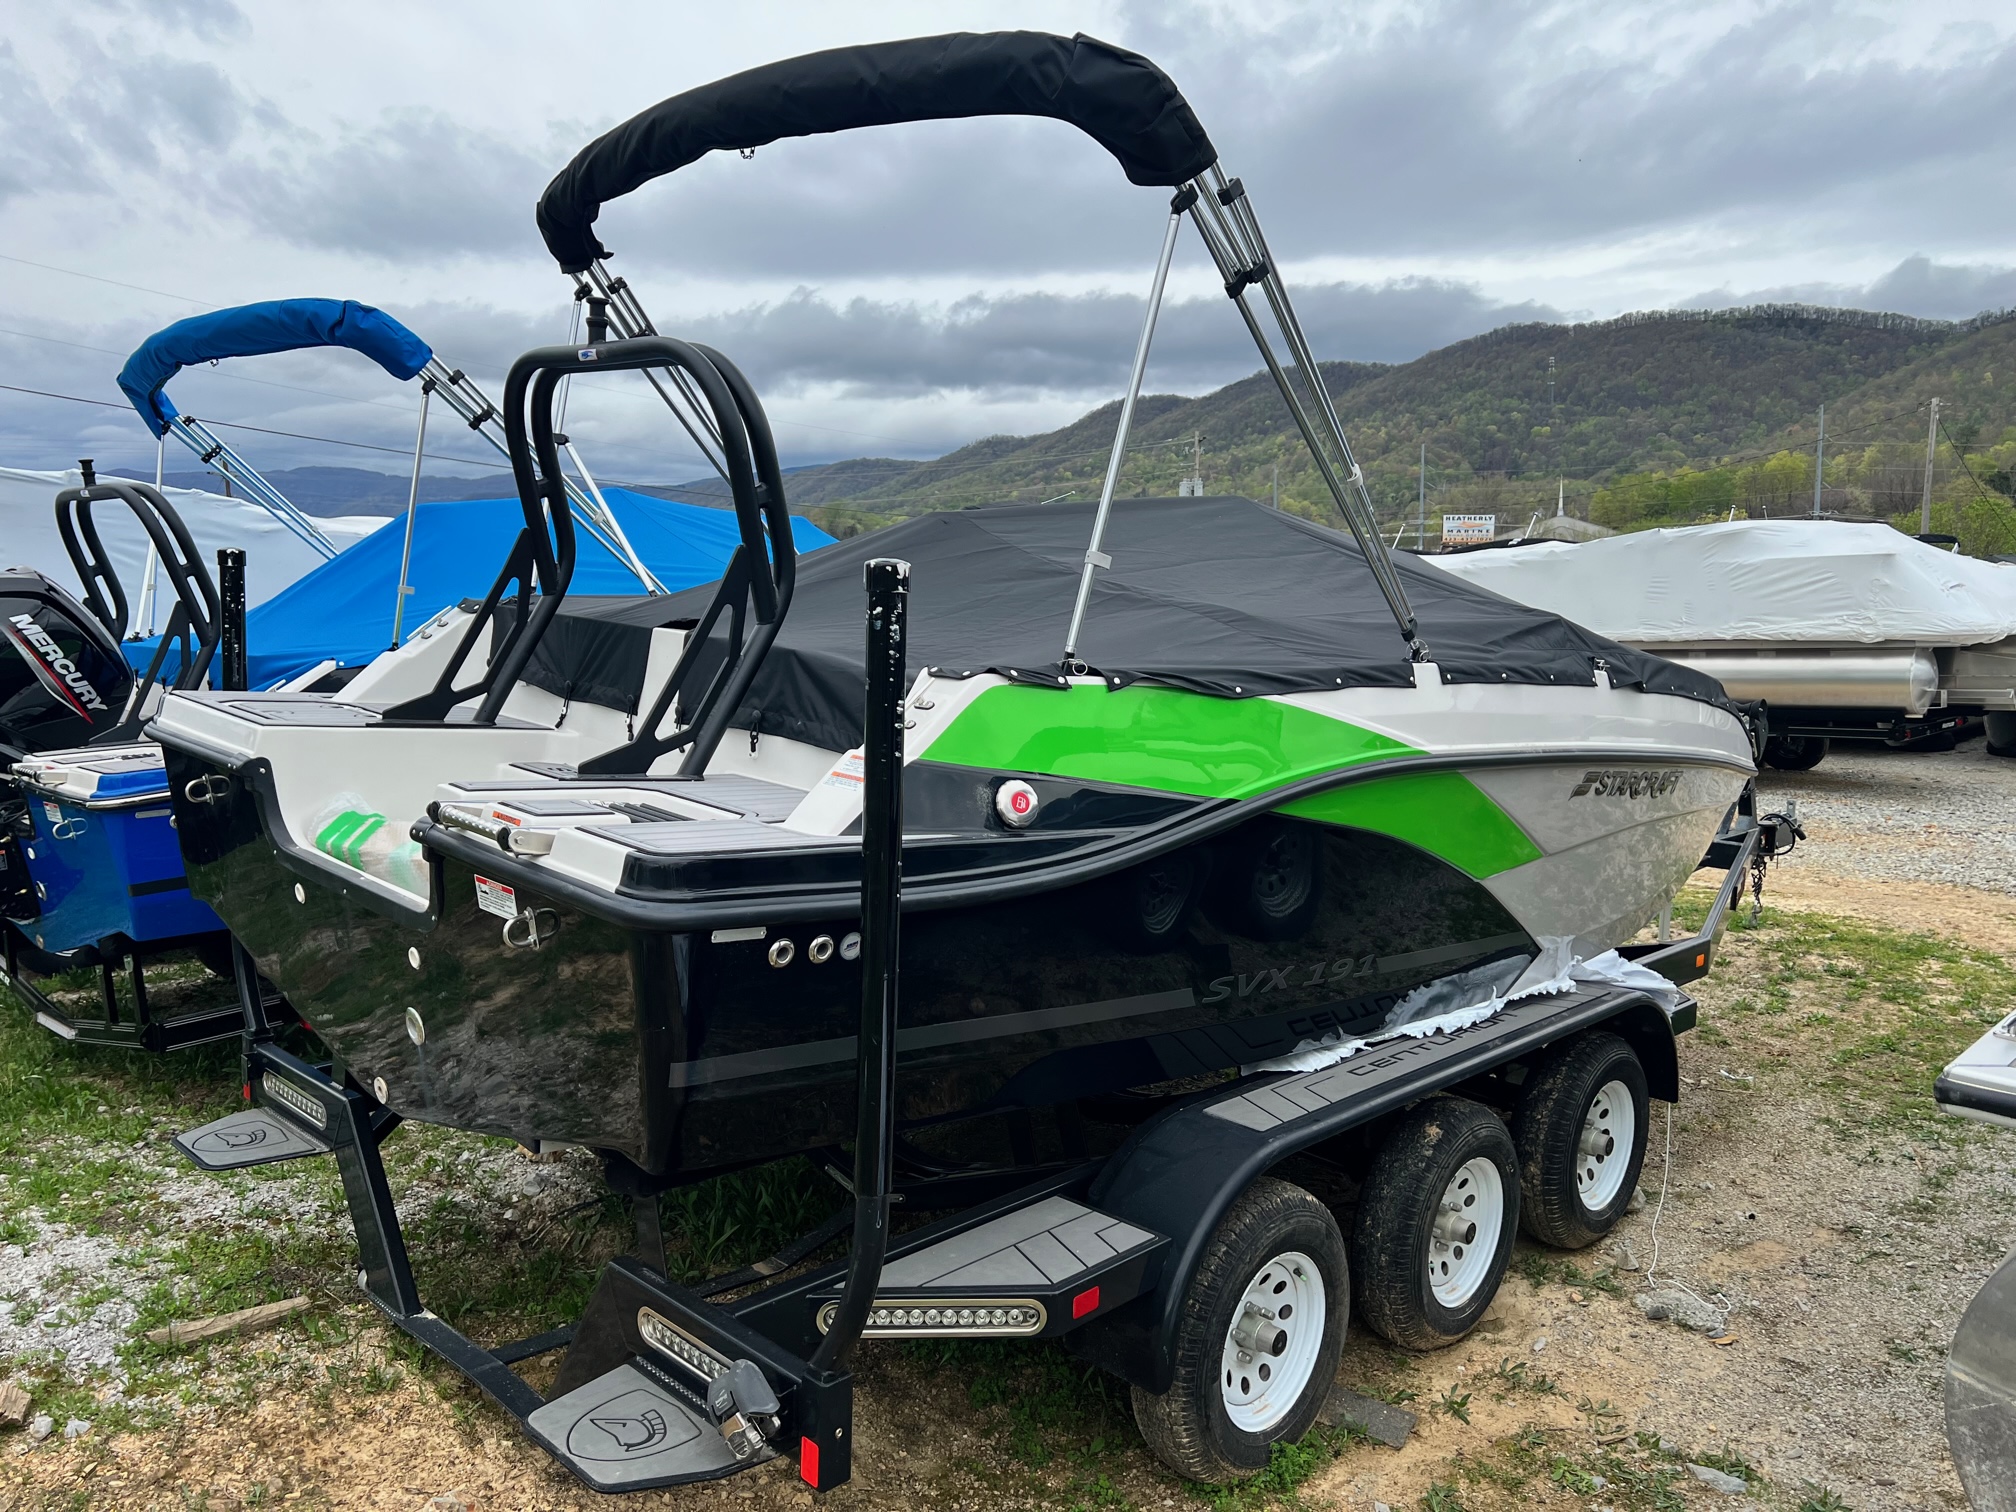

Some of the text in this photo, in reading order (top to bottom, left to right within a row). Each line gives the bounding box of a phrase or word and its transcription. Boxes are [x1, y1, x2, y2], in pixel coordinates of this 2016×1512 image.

[9, 613, 108, 711] MERCURY
[1594, 770, 1684, 799] STARCRAFT
[1202, 954, 1375, 1003] SVX 191
